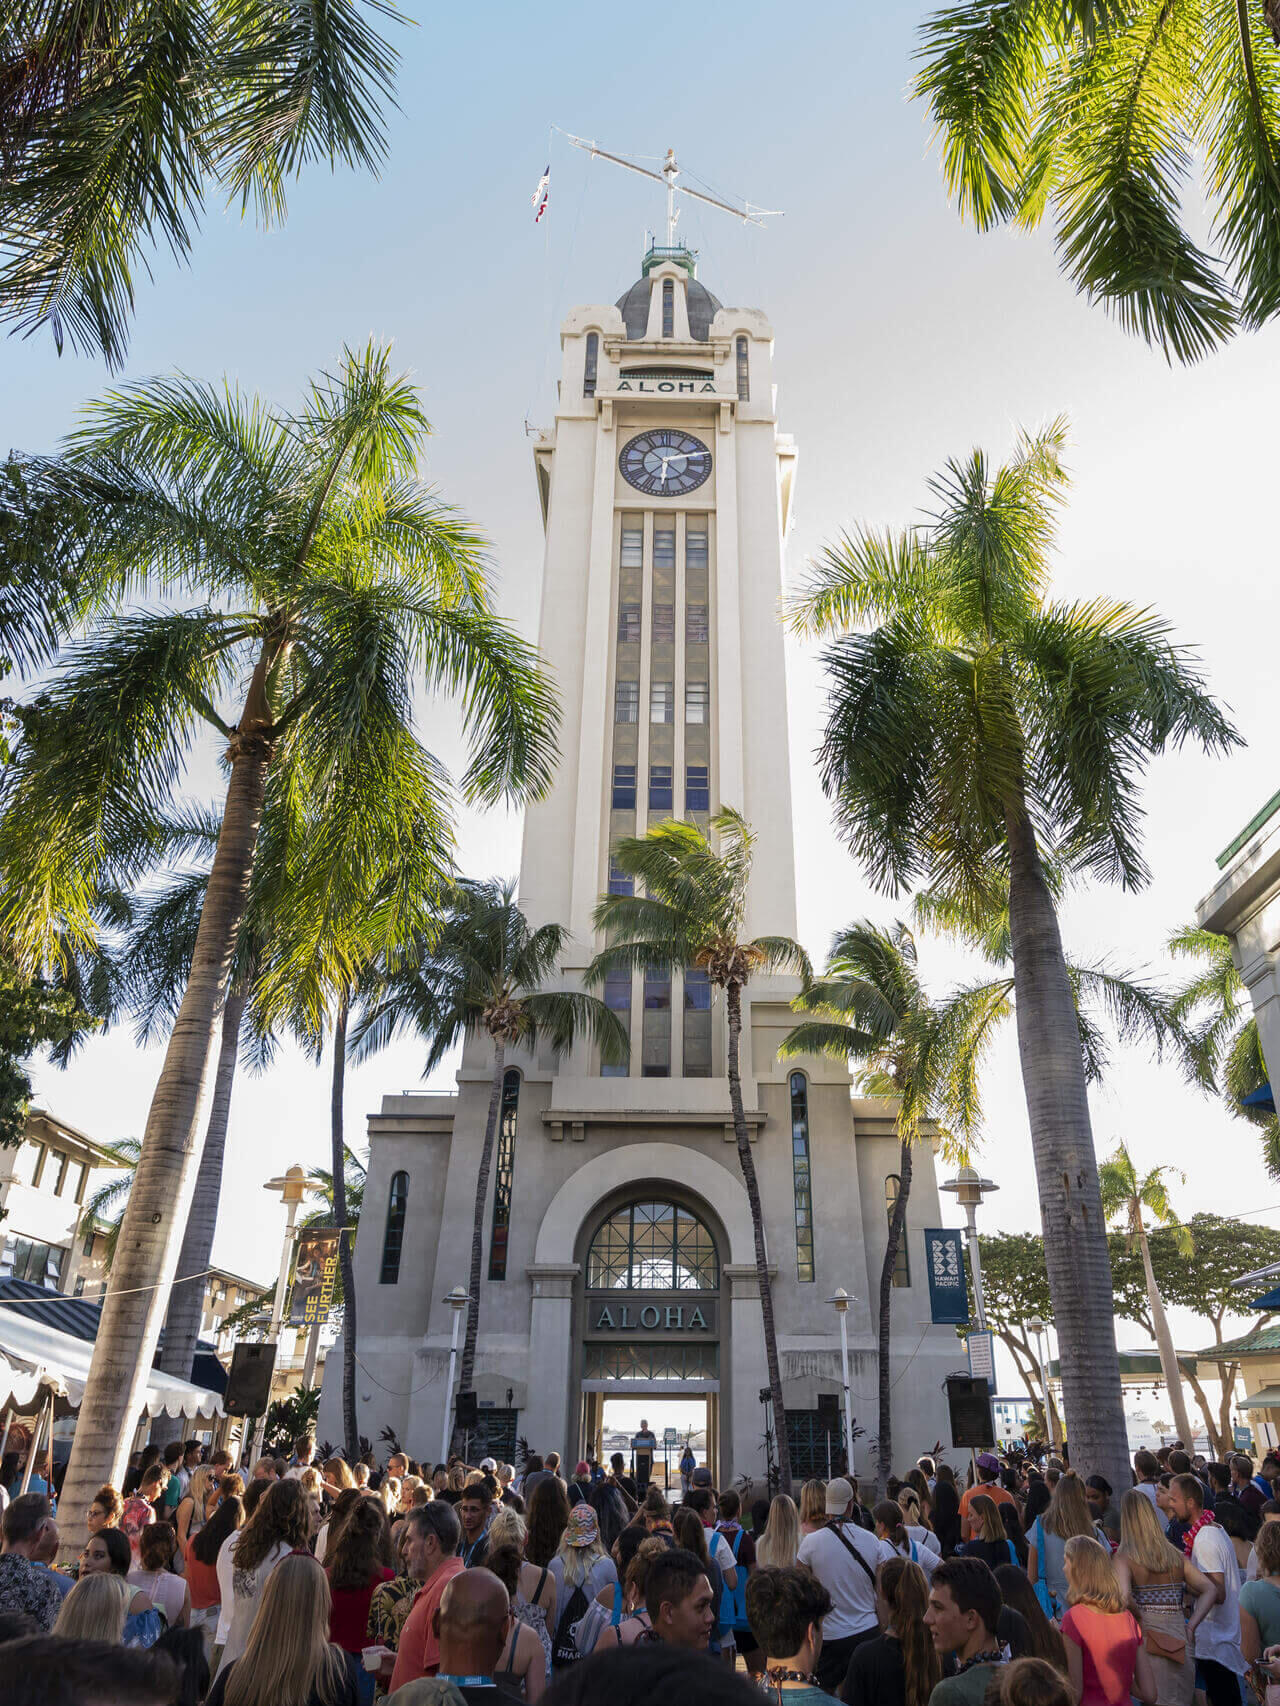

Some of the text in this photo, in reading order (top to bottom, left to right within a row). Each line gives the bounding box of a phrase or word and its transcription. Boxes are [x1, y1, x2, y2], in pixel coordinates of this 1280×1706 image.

[617, 380, 718, 393] ALOHA
[317, 1254, 338, 1323] FURTHER.
[304, 1295, 319, 1323] SEE
[596, 1305, 708, 1328] ALOHA
